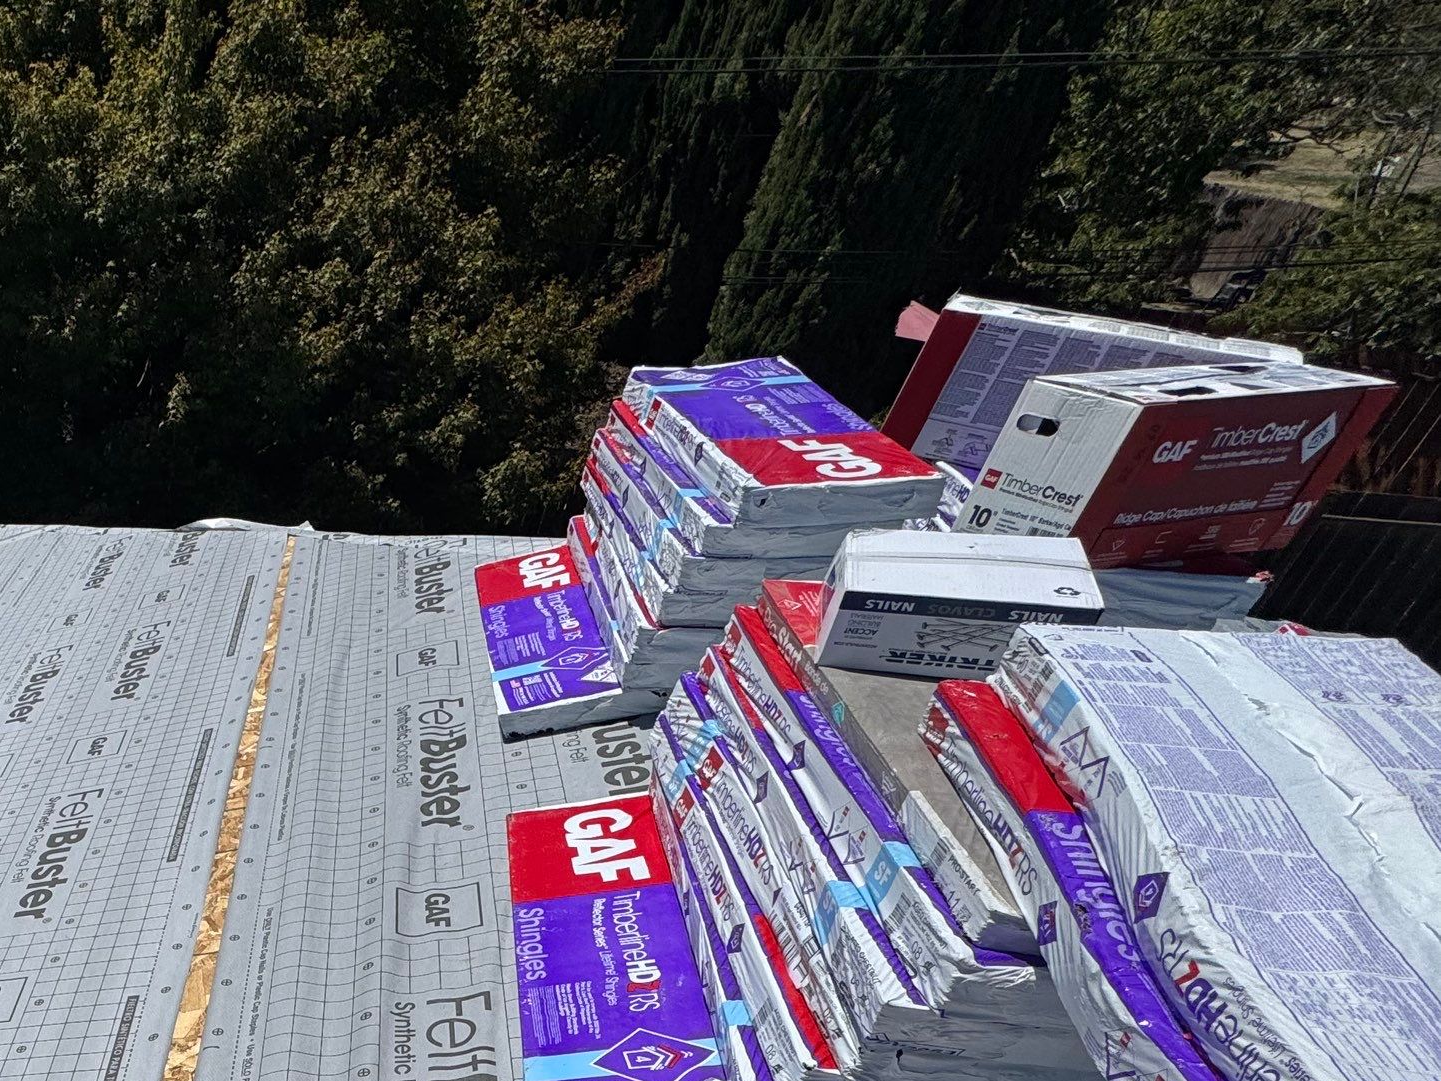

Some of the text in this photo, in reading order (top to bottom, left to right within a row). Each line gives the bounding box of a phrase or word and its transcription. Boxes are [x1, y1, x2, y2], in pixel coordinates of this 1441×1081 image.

[777, 437, 882, 478] GAF
[1152, 440, 1198, 463] GAF
[519, 553, 571, 589] GAF
[864, 599, 1065, 623] NAILS CLAVOS NAILS
[843, 627, 879, 637] ACCENT
[111, 620, 172, 701] FeltBuster
[418, 647, 437, 667] GAF
[5, 644, 74, 724] FeltBuster
[87, 736, 108, 756] GAF
[564, 807, 650, 884] GAF
[425, 893, 452, 929] GAF
[518, 907, 546, 980] Shingles
[627, 991, 660, 1012] RS
[391, 1001, 417, 1077] Synthetic
